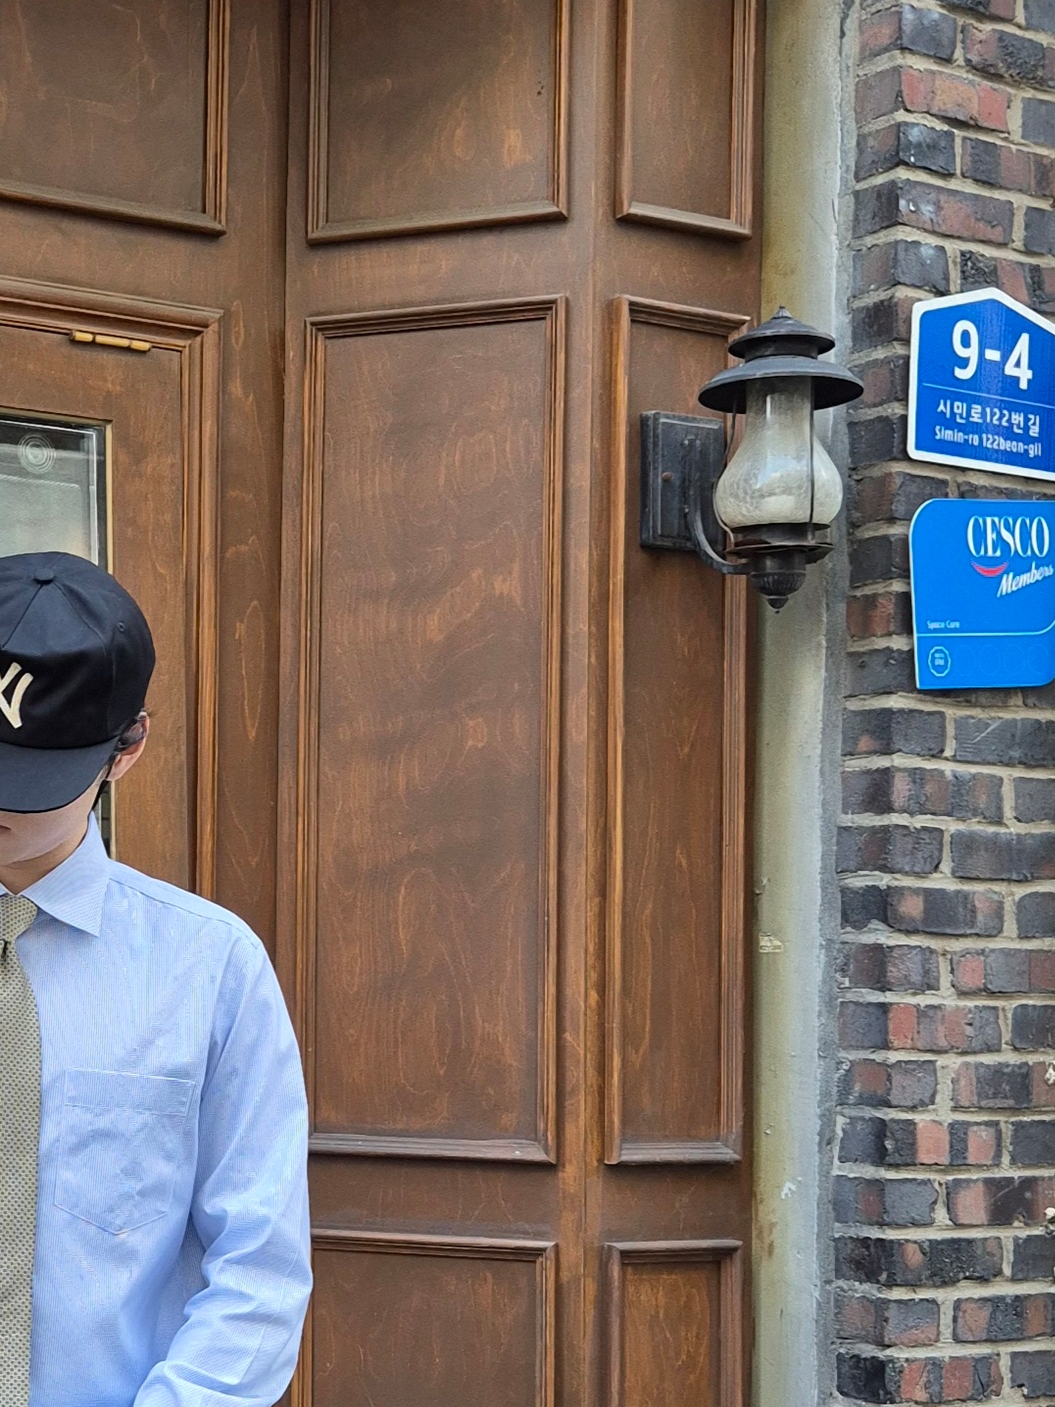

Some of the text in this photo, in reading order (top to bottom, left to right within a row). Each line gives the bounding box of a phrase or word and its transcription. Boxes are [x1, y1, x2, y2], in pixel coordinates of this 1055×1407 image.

[952, 319, 1033, 391] 9-4
[936, 398, 1040, 438] 시민로122번길
[934, 425, 1042, 458] Simin-ro 122beon-gil
[967, 515, 1050, 558] CESCO
[996, 560, 1054, 599] Members
